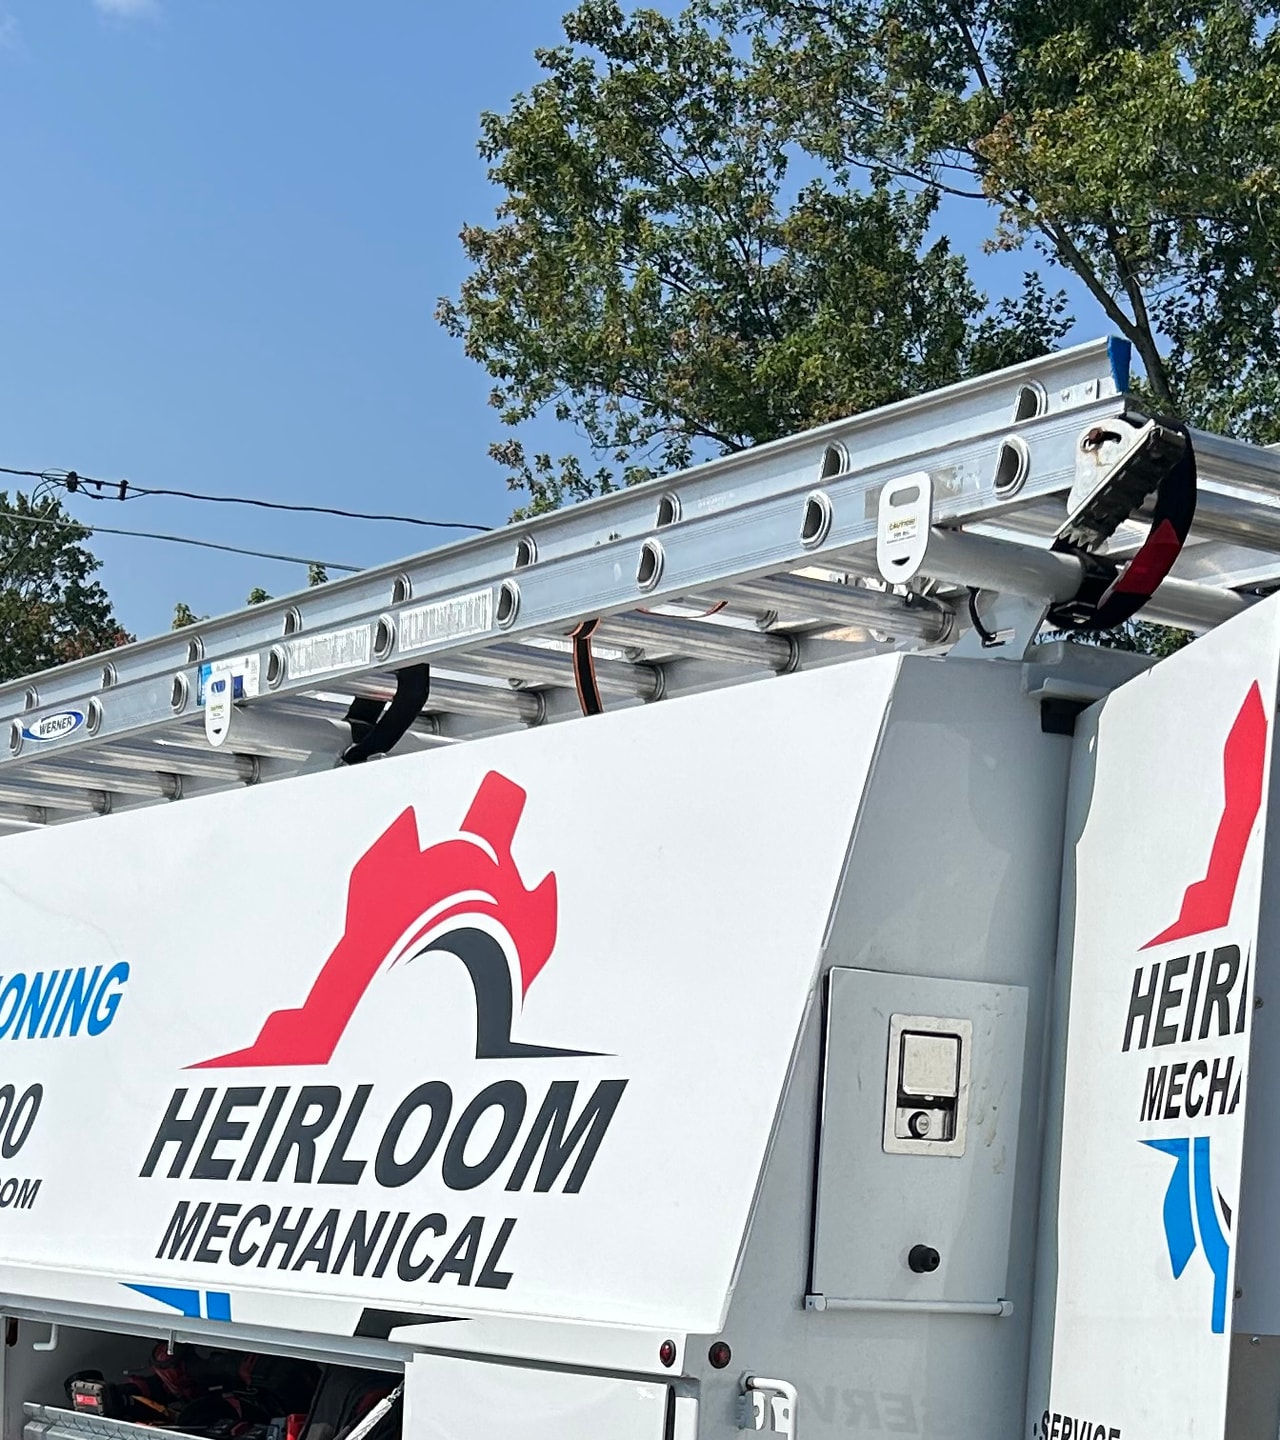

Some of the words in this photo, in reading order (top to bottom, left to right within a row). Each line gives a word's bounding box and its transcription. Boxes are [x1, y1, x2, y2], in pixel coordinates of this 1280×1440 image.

[39, 715, 73, 736] WERNER
[138, 1078, 630, 1195] HEIRLOOM
[154, 1200, 518, 1291] MECHANICAL
